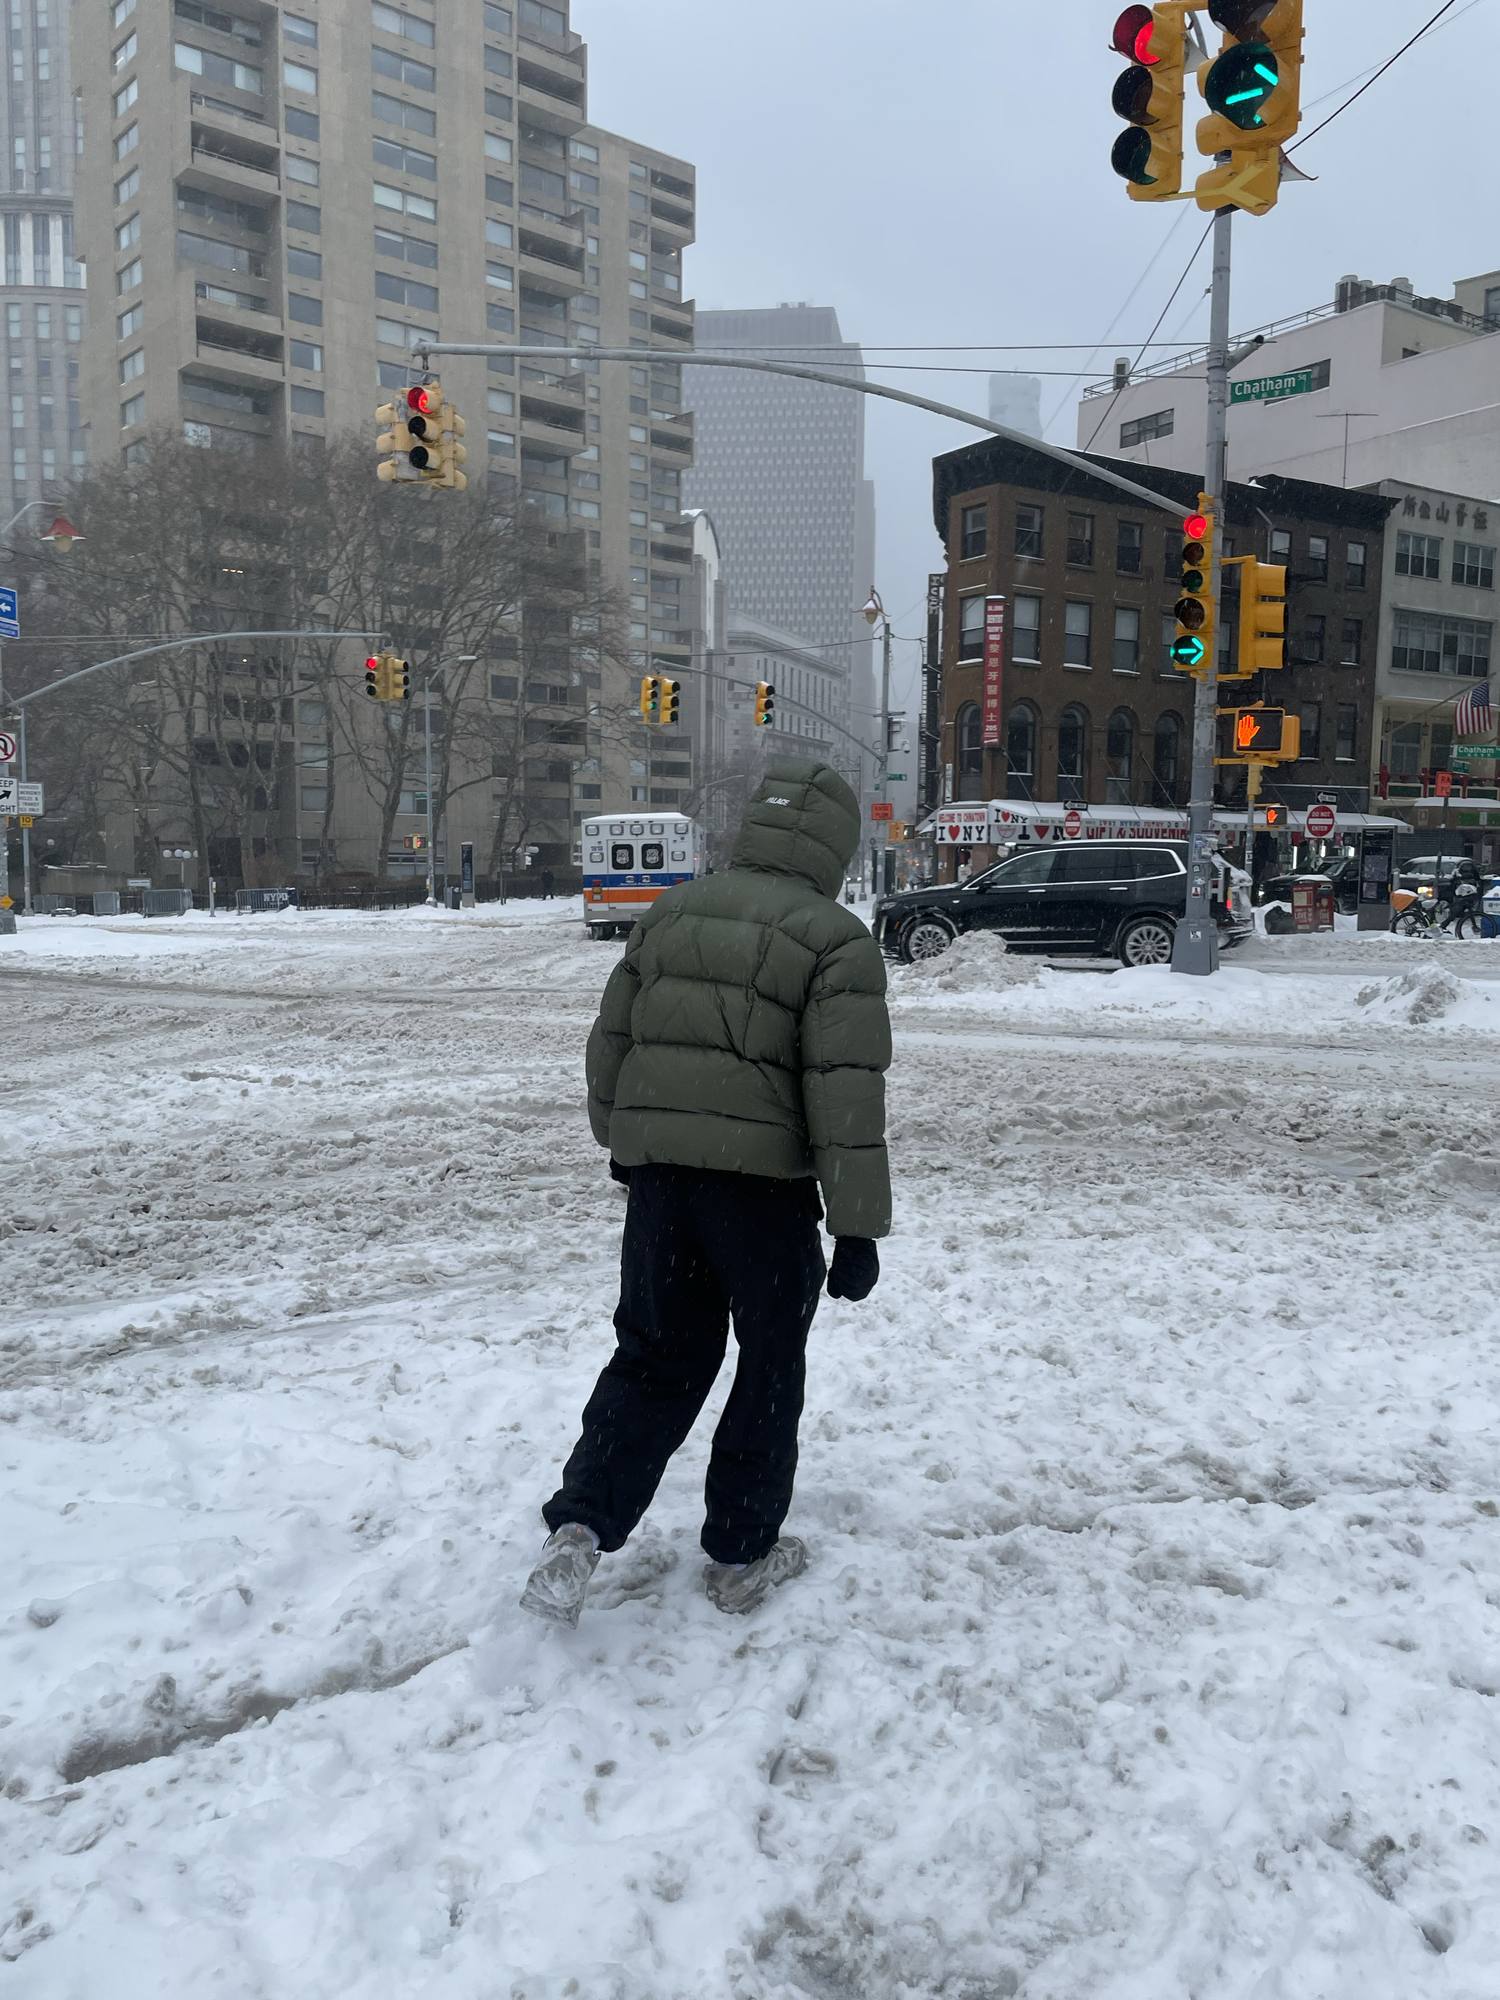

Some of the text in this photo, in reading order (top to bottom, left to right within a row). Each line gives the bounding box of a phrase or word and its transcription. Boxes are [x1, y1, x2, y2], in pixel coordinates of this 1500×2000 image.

[1234, 376, 1296, 396] Chatham
[1458, 746, 1495, 754] Chatham
[0, 780, 14, 788] EEP
[0, 805, 16, 813] GHT
[994, 808, 1001, 823] I
[1011, 813, 1028, 824] NY
[938, 826, 946, 841] I
[962, 825, 985, 841] NY
[263, 893, 288, 902] NYPD
